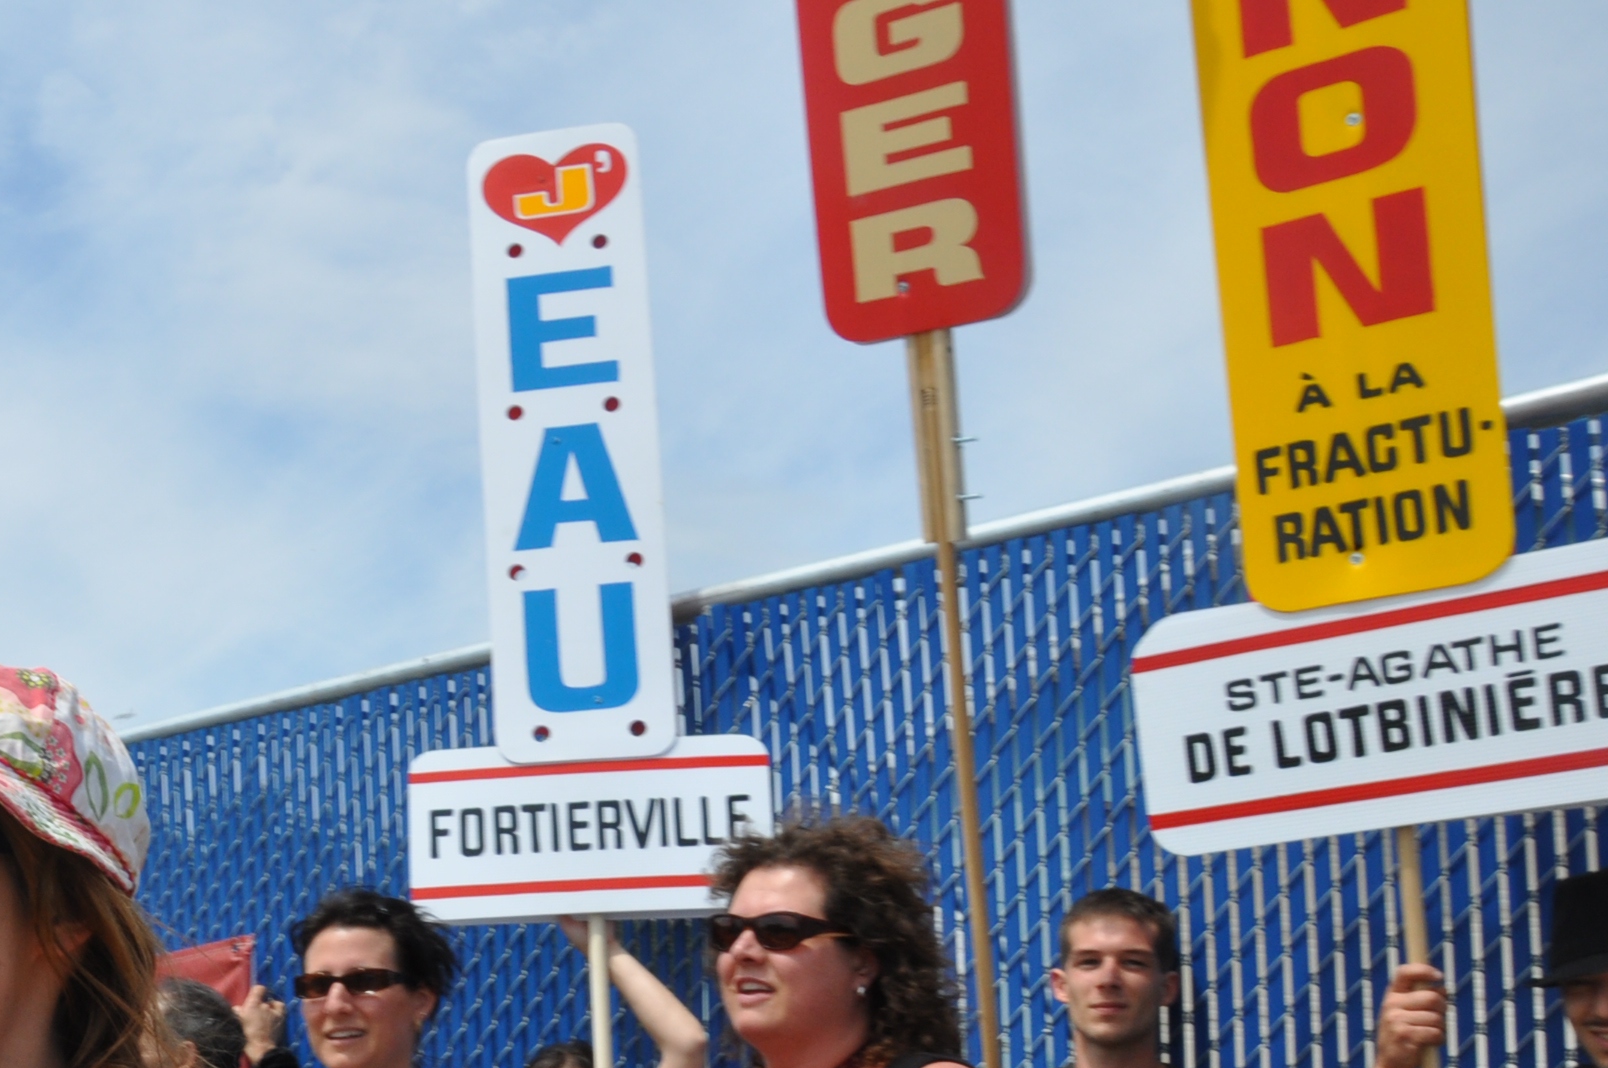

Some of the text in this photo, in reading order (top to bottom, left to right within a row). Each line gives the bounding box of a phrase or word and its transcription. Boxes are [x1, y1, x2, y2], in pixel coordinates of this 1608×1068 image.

[1296, 361, 1426, 414] À LA
[505, 265, 640, 713] EAU
[1274, 480, 1474, 564] RATION
[1224, 622, 1566, 713] STE-AGATHE
[1183, 725, 1253, 784] DE
[428, 794, 750, 859] FORTIERVILLE
